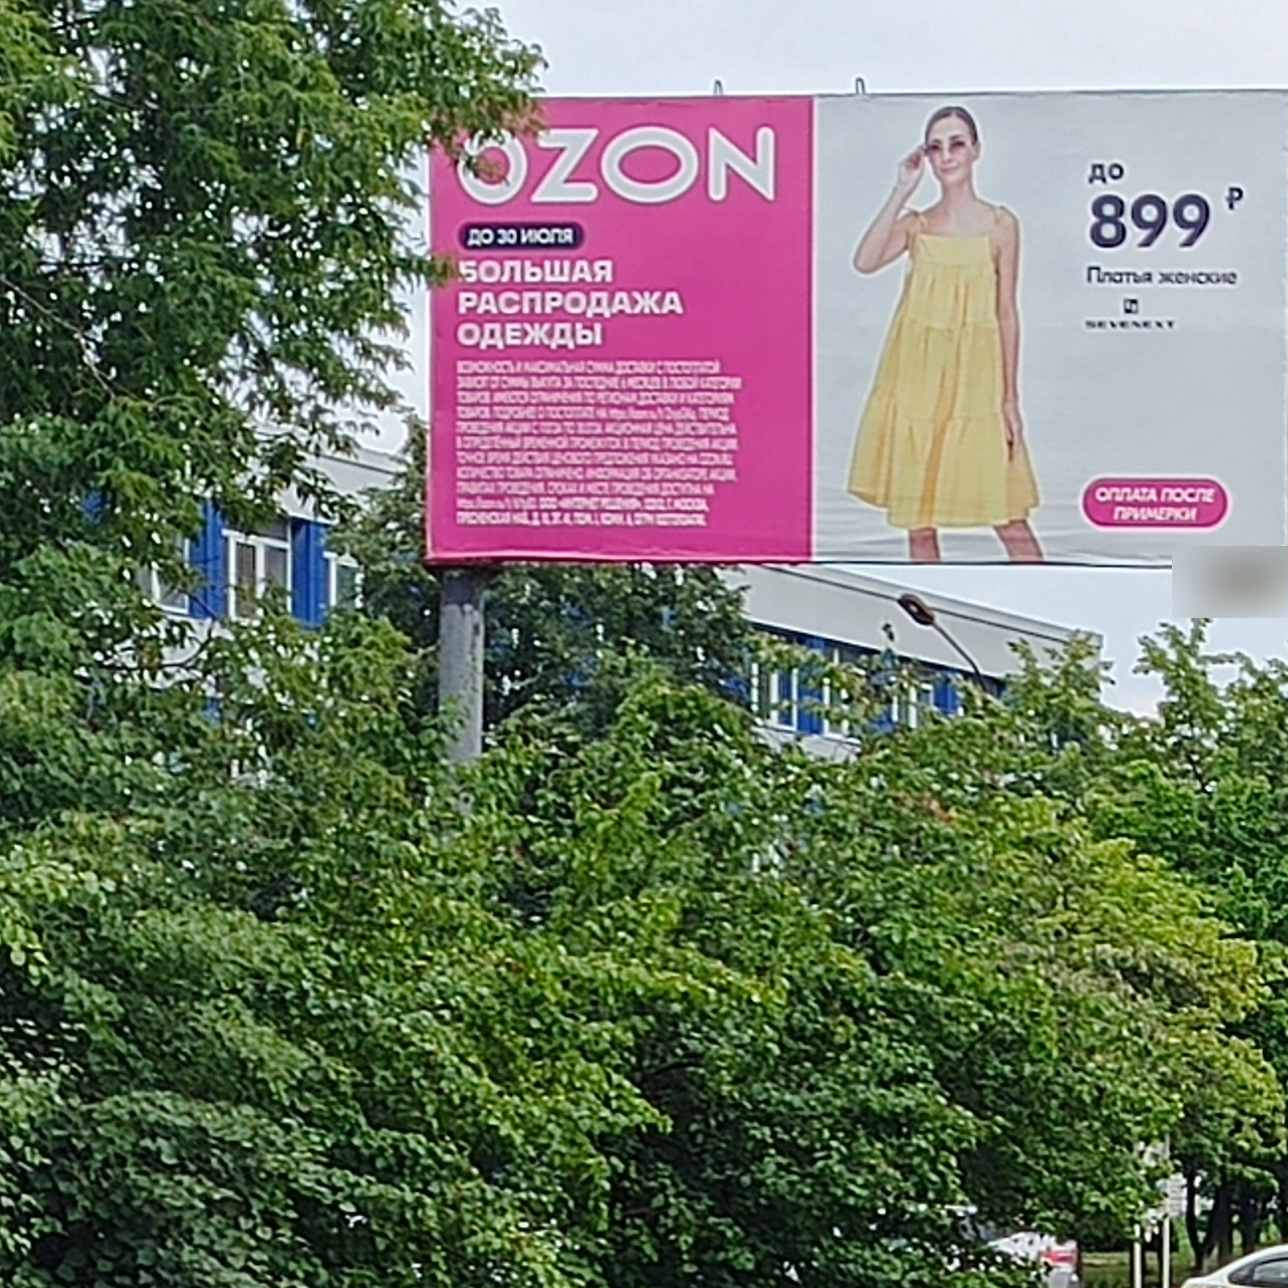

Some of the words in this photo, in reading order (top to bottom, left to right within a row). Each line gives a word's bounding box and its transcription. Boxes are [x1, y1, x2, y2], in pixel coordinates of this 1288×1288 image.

[457, 126, 776, 205] OZON
[1089, 193, 1211, 249] 899
[467, 228, 495, 246] ДО
[497, 228, 517, 245] 30
[520, 228, 573, 245] ИЮЛЯ
[458, 259, 613, 283] БОЛЬШАЯ
[1086, 266, 1153, 284] Платья
[1157, 271, 1238, 285] женские
[458, 291, 683, 318] РАСПРОДАЖА
[457, 322, 602, 350] ОДЕЖДЫ
[1095, 487, 1157, 503] ОПЛАТА
[1161, 487, 1215, 503] ПОСЛЕ
[1113, 506, 1198, 521] ПРИМЕРКИ
